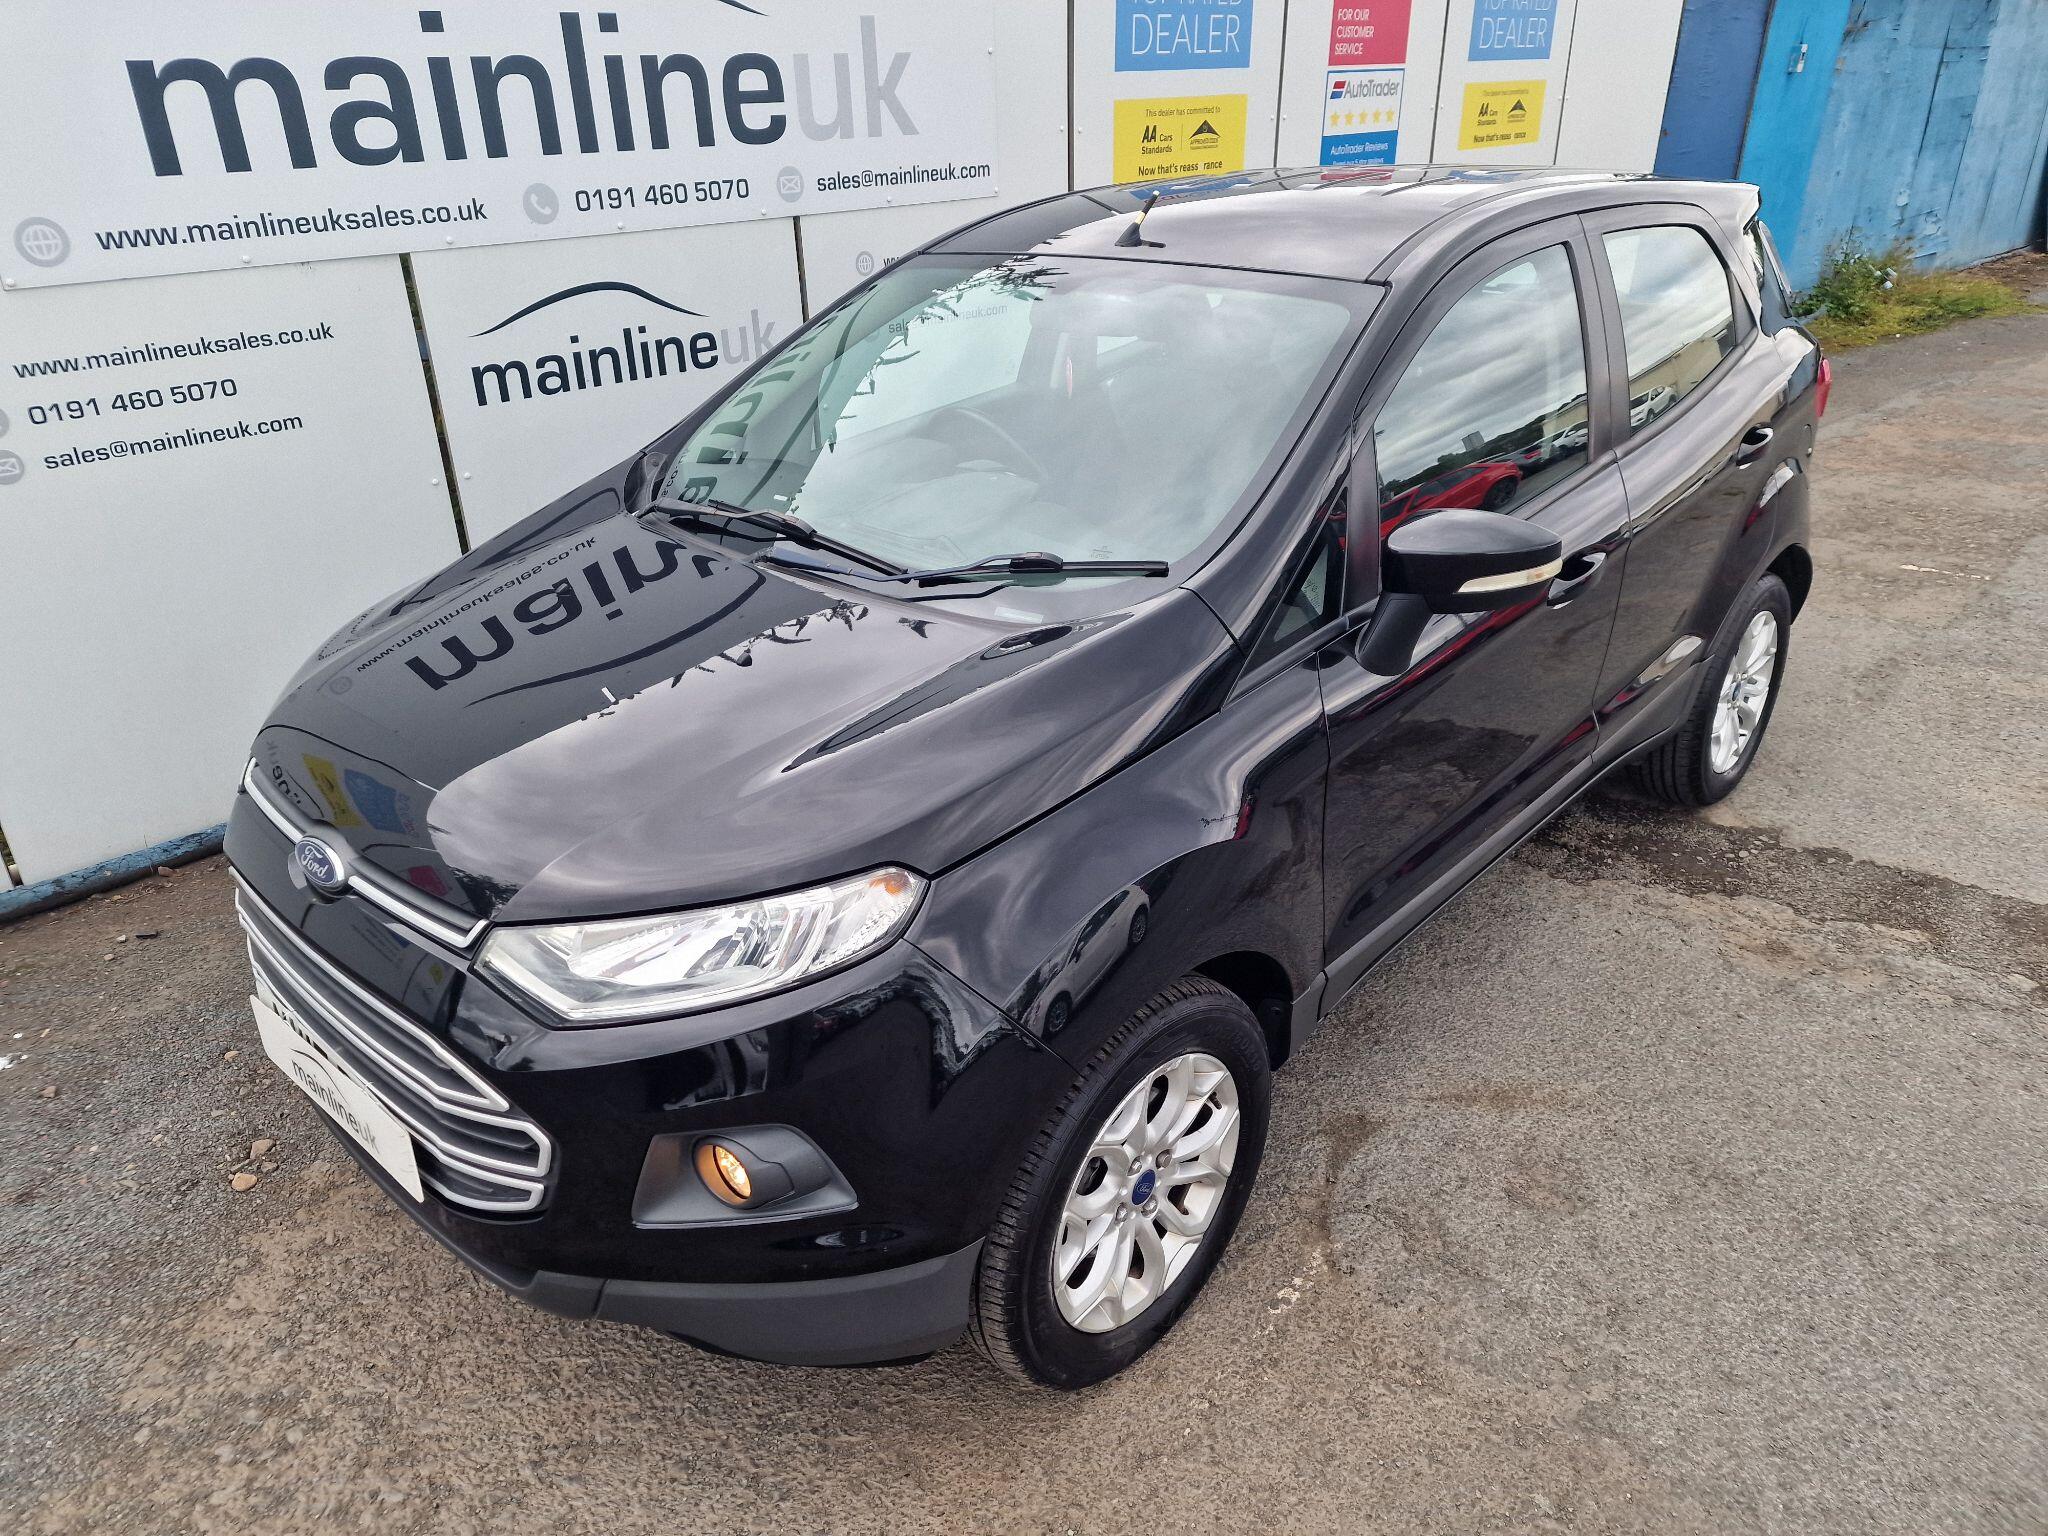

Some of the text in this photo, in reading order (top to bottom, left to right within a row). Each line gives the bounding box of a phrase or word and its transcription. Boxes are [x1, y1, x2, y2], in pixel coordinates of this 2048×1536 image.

[1337, 8, 1370, 20] FOR OUR
[1131, 13, 1240, 55] DEALER
[1336, 25, 1374, 38] CUSTOMER
[1479, 17, 1548, 48] DEALER
[1334, 42, 1363, 55] SERVICE
[1343, 79, 1400, 98] AutoTrader
[1146, 108, 1157, 117] This
[1158, 107, 1175, 117] dealer
[1176, 107, 1186, 116] has
[1142, 124, 1173, 143] AA Cars
[1141, 144, 1173, 155] Standards
[816, 162, 991, 192] sales@mainlineuk.com
[1138, 165, 1156, 177] Now
[1157, 163, 1178, 175] that's
[575, 178, 750, 213] 0191 460 5070
[95, 197, 489, 251] www.mainlineuksales.co.uk
[12, 321, 336, 379] www.mainlineuksales.co.uk
[27, 378, 239, 426] 0191 460 5070
[43, 414, 304, 470] sales@mainlineuk.com
[300, 845, 330, 879] Ford
